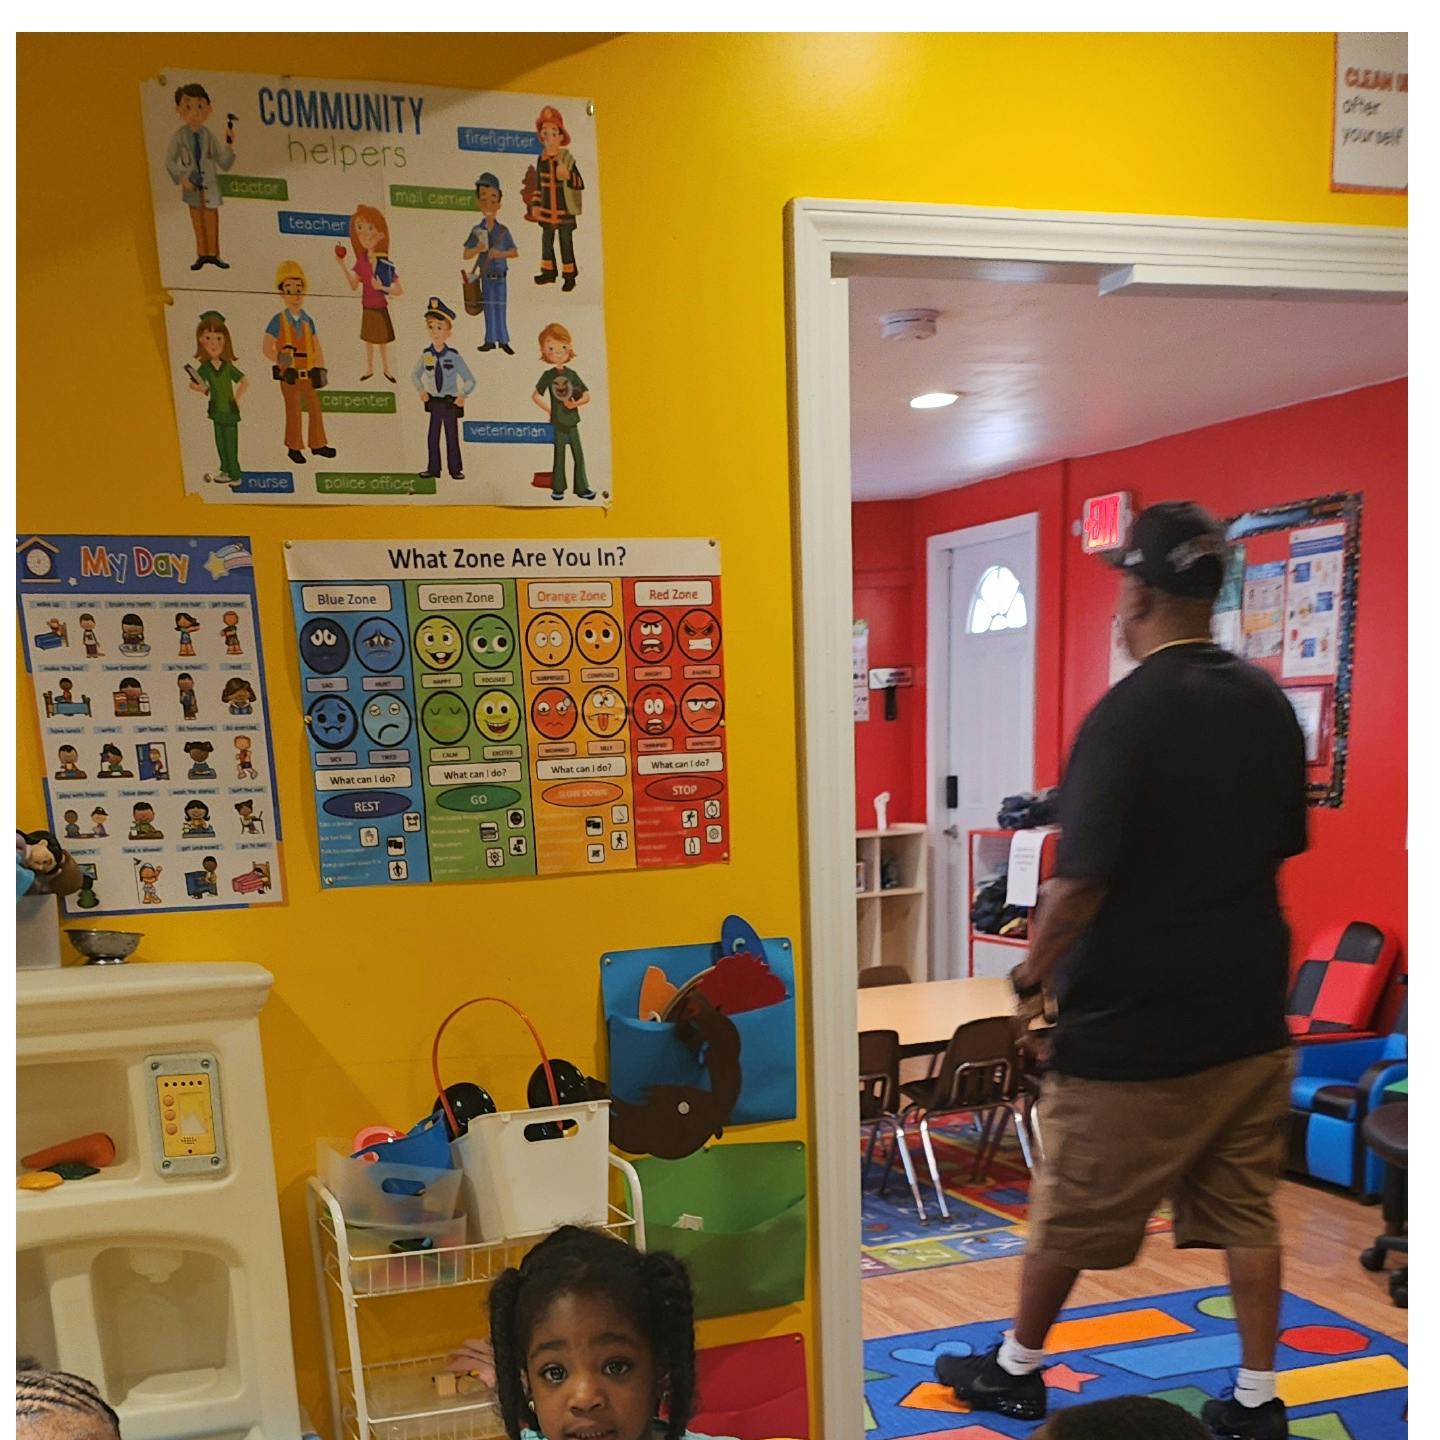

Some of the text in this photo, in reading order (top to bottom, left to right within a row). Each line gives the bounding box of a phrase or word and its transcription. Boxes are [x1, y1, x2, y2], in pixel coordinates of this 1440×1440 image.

[1344, 67, 1393, 92] CLEAN
[258, 86, 424, 135] COMMUNITY
[465, 131, 536, 152] firefighter
[287, 134, 408, 171] helpers
[229, 178, 280, 195] doctor
[395, 189, 472, 207] mail carrier
[289, 214, 347, 232] teacher
[322, 392, 390, 411] carpenter
[470, 424, 547, 439] veterinarian
[248, 475, 289, 490] nurse
[324, 474, 417, 492] police officer
[80, 546, 190, 584] My Day
[388, 546, 627, 569] What Zone Are You In?
[317, 593, 377, 606] Blue Zone
[428, 592, 495, 605] Green Zone
[537, 590, 607, 605] Orange Zone
[649, 589, 699, 600] Red Zone
[550, 765, 574, 775] What
[575, 766, 590, 774] can
[597, 764, 612, 773] do?
[651, 760, 674, 770] What
[675, 761, 689, 769] can
[695, 758, 710, 767] do?
[329, 776, 355, 786] What
[357, 777, 372, 785] can
[379, 774, 396, 784] do?
[443, 770, 468, 780] What
[491, 769, 507, 778] do?
[672, 785, 698, 797] STOP
[354, 801, 381, 814] REST
[470, 794, 488, 806] GO
